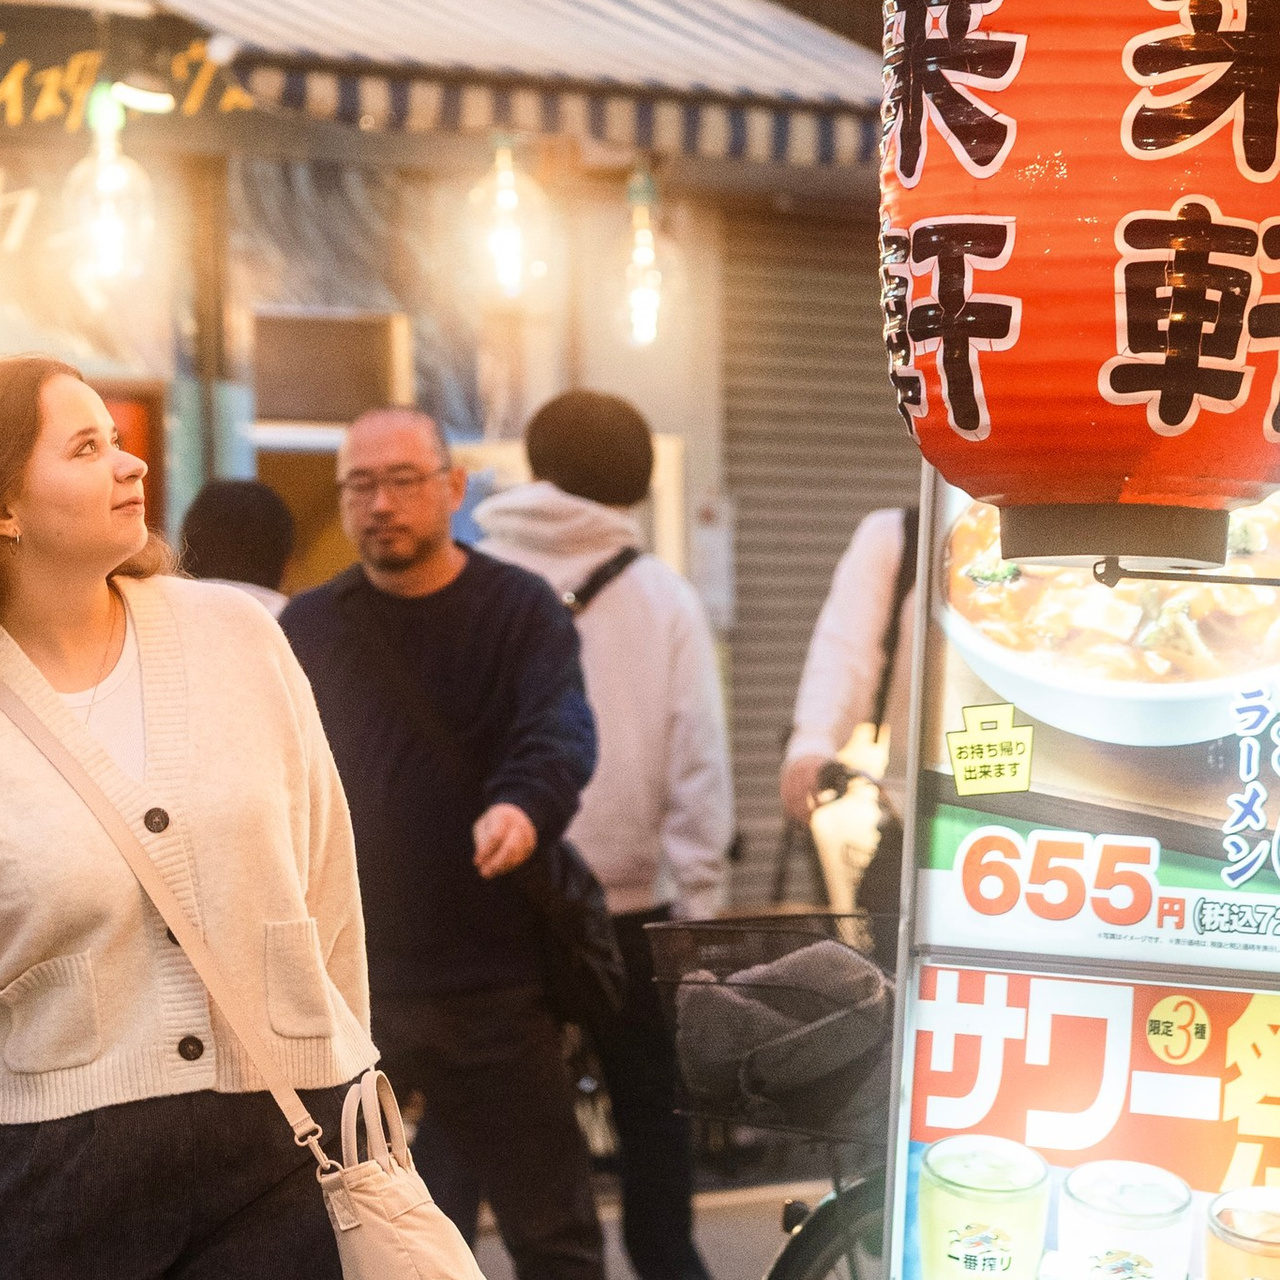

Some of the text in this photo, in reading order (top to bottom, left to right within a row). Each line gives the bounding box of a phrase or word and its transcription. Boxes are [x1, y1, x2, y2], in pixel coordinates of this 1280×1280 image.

[956, 741, 1026, 760] お持ち帰り
[964, 762, 1020, 781] 出来ます
[1223, 683, 1271, 886] ラーメン
[962, 834, 1186, 930] 655円
[947, 1253, 1012, 1272] 一番搾り
